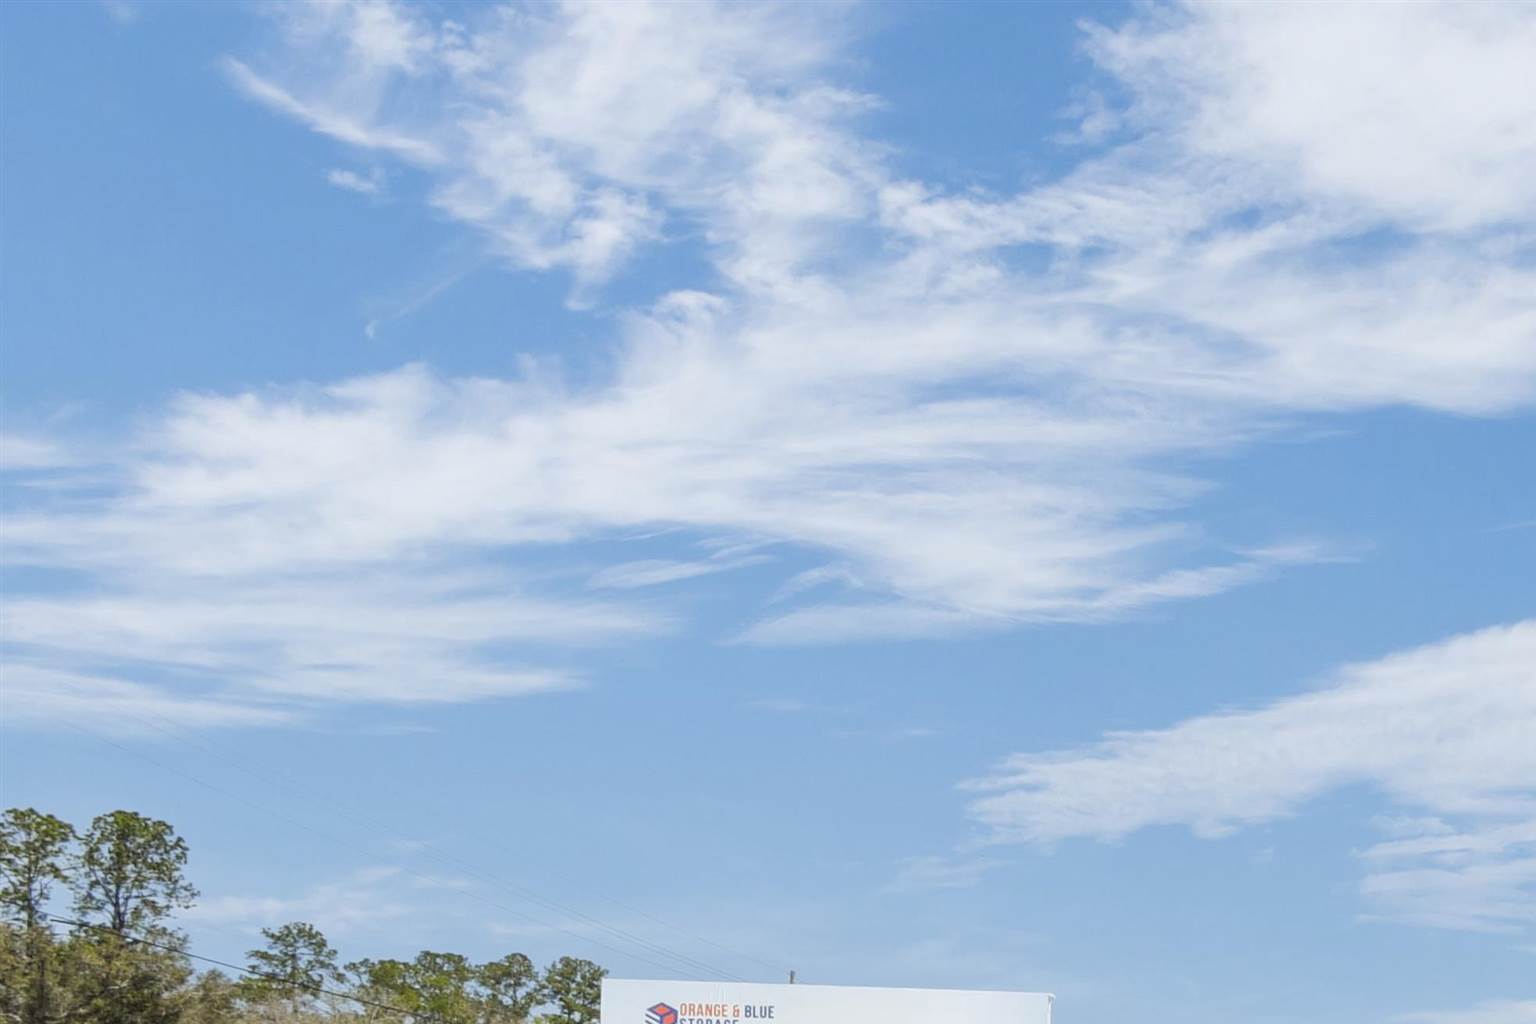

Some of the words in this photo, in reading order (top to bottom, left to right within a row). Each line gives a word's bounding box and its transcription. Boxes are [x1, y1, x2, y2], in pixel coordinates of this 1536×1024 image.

[679, 1002, 729, 1018] ORANGE
[732, 1005, 741, 1019] &
[744, 1005, 775, 1019] BLUE
